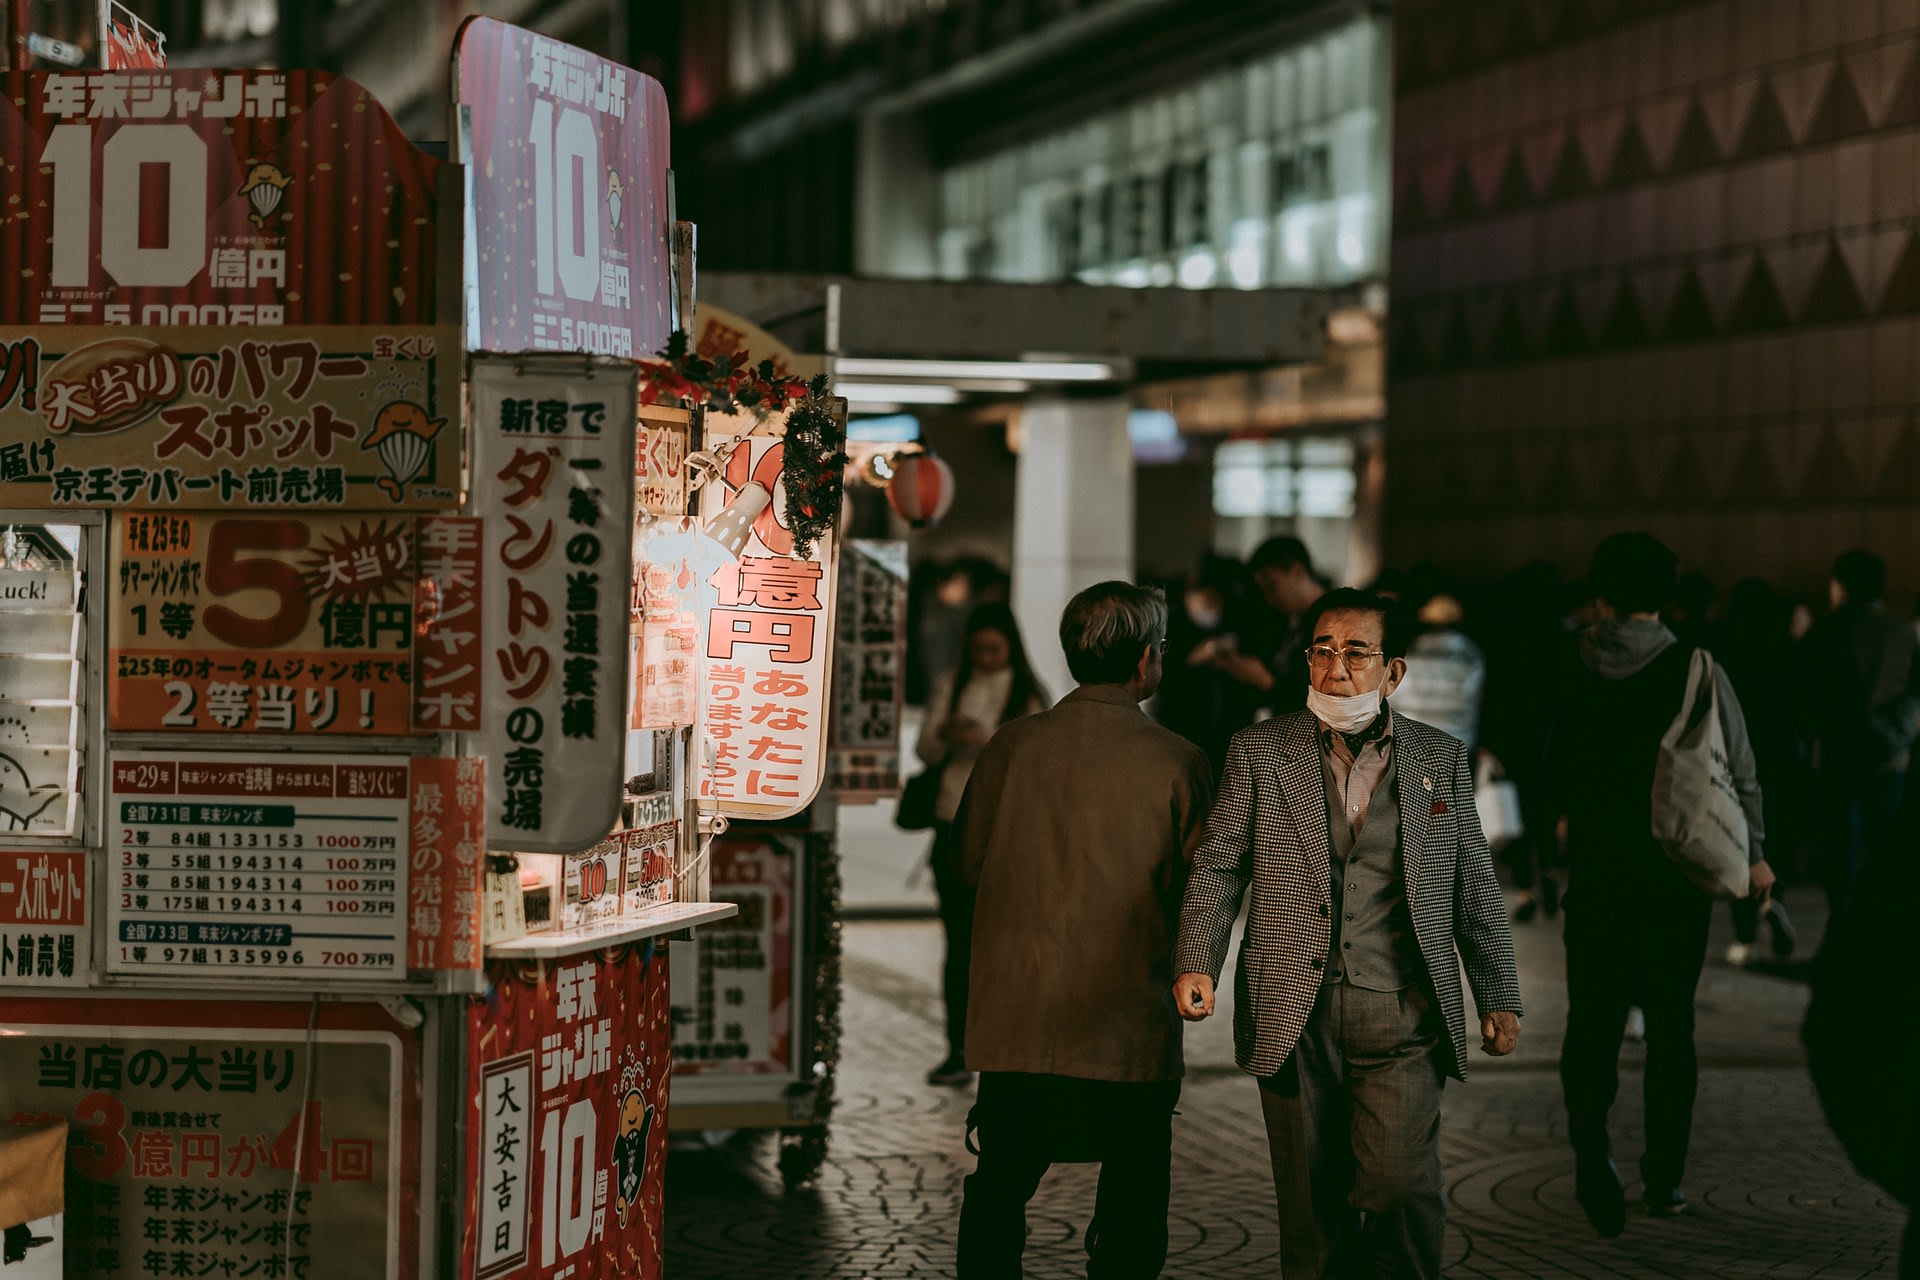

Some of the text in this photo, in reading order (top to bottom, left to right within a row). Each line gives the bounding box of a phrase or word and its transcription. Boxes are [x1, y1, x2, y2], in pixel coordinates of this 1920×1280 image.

[43, 74, 286, 118] 年末ジャンボ
[530, 36, 627, 118] 年末ジャンボ
[40, 125, 207, 287] 10
[529, 98, 599, 302] 10
[374, 337, 435, 358] 宝くじ
[156, 404, 356, 459] スポット
[501, 398, 606, 435] 新宿で
[53, 467, 345, 502] 京王デパート前売場
[129, 517, 191, 551] 平成25年の
[121, 558, 201, 596] サマージャンボで
[319, 539, 410, 590] 大当り
[0, 580, 47, 600] uck!
[131, 601, 195, 640] 1等
[418, 519, 479, 726] 年末ジャンボ
[746, 669, 810, 798] あなたに
[117, 765, 170, 789] 平成29年
[122, 829, 150, 845] 2等
[316, 835, 396, 849] 1000万円
[122, 852, 149, 868] 3等
[326, 858, 396, 872] 100万円
[122, 873, 149, 889] 3等
[326, 879, 395, 893] 100万円
[121, 893, 149, 910] 3等
[326, 900, 395, 914] 100万円
[322, 951, 394, 966] 700万円
[556, 960, 598, 1024] 年末
[38, 1044, 294, 1093] 当店の大当り
[541, 1017, 612, 1093] ジャンボ
[492, 1077, 522, 1253] 大安吉日
[540, 1098, 597, 1269] 10
[144, 1184, 313, 1215] 年末ジャンボで
[143, 1217, 312, 1249] 年末ジャンボで
